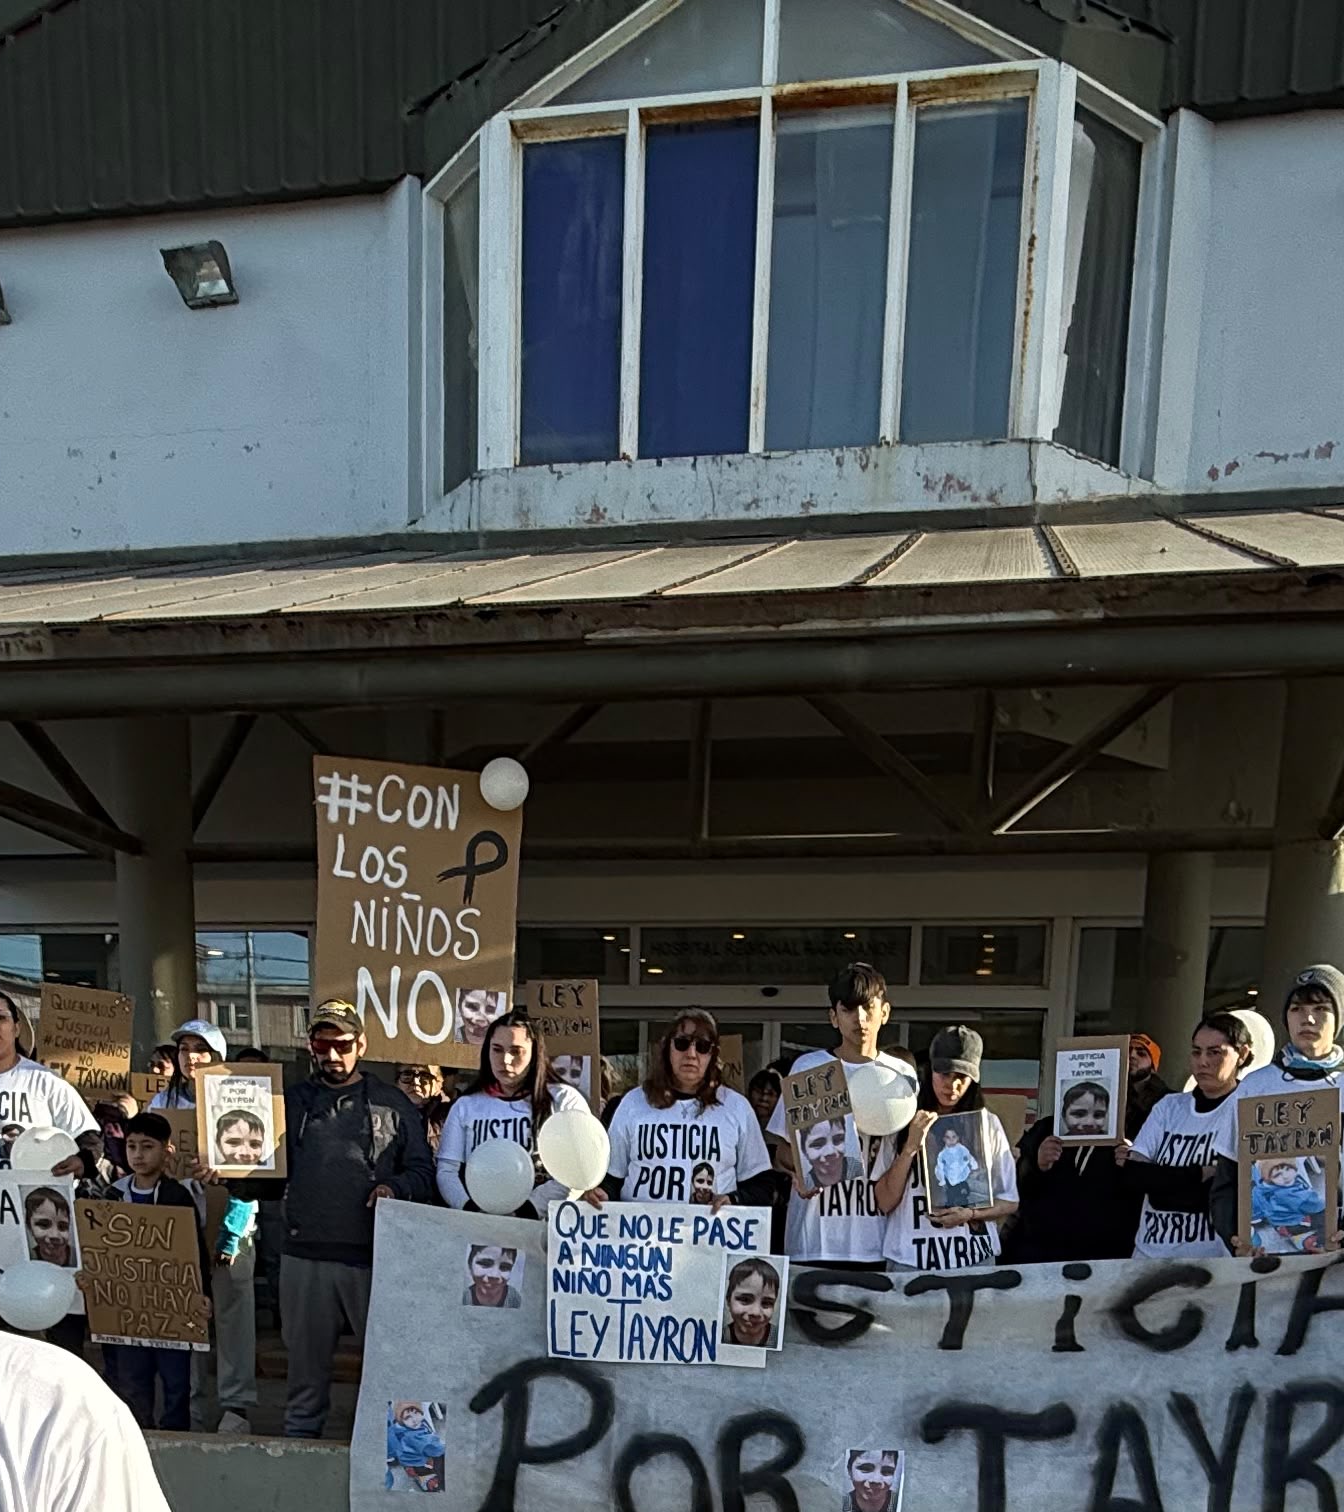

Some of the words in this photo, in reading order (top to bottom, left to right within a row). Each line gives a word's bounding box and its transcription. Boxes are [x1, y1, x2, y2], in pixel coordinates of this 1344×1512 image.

[317, 771, 460, 830] #CON
[333, 833, 407, 888] LOS
[50, 993, 117, 1018] QUEREMOS
[356, 965, 453, 1044] NO
[538, 983, 586, 1008] LEY
[56, 1017, 111, 1040] JUSTICIA
[78, 1055, 93, 1067] NO
[1068, 1052, 1106, 1061] JUSTICIA
[1071, 1069, 1103, 1077] TAYRON
[75, 1066, 129, 1091] TAYRON
[146, 1078, 169, 1094] LE
[228, 1087, 247, 1095] POR
[1256, 1098, 1315, 1127] LEY
[472, 1116, 532, 1152] JUSTIC
[638, 1123, 721, 1162] JUSTICIA
[633, 1165, 685, 1200] POR
[820, 1179, 885, 1217] TAYRO
[555, 1200, 609, 1243] QUE
[619, 1214, 653, 1240] NO
[657, 1217, 684, 1244] LE
[693, 1215, 760, 1250] PASE
[82, 1247, 199, 1292] JUSTICIA
[557, 1240, 575, 1265] A
[581, 1241, 673, 1273] NINGÚN
[912, 1236, 994, 1271] TAYRON
[93, 1279, 129, 1305] NO
[141, 1286, 193, 1313] HAY
[552, 1267, 612, 1297] NIÑO
[621, 1271, 673, 1302] MÁS
[120, 1308, 180, 1338] PAZ
[550, 1298, 610, 1359] LEY
[606, 1298, 718, 1364] TAYRON
